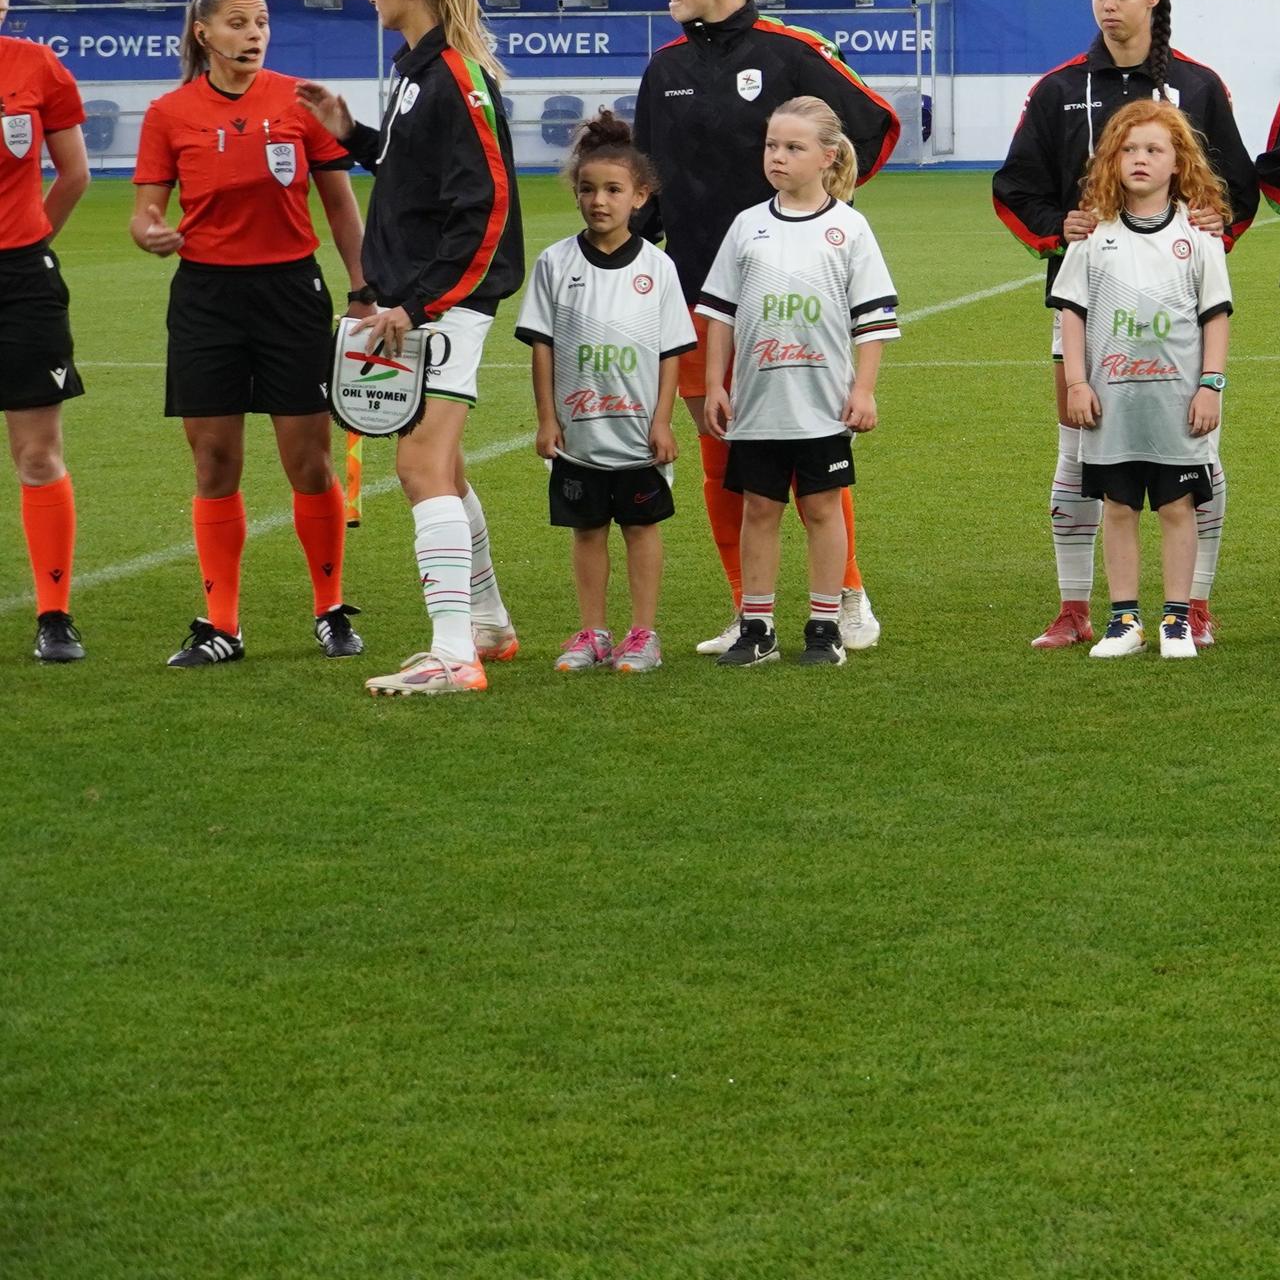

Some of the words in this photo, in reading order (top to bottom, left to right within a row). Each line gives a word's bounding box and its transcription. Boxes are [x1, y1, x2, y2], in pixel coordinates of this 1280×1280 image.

[79, 35, 181, 57] POWER
[509, 32, 610, 55] POWER
[835, 30, 935, 52] POWER
[664, 88, 694, 97] STANNO
[752, 338, 827, 367] Ritchie
[1101, 352, 1181, 379] Ritchie
[342, 388, 362, 398] OHL
[366, 389, 407, 403] WOMEN
[368, 399, 381, 410] 18
[564, 388, 646, 418] Ritchie
[828, 459, 849, 473] JAKO
[1178, 472, 1199, 483] JAKO
